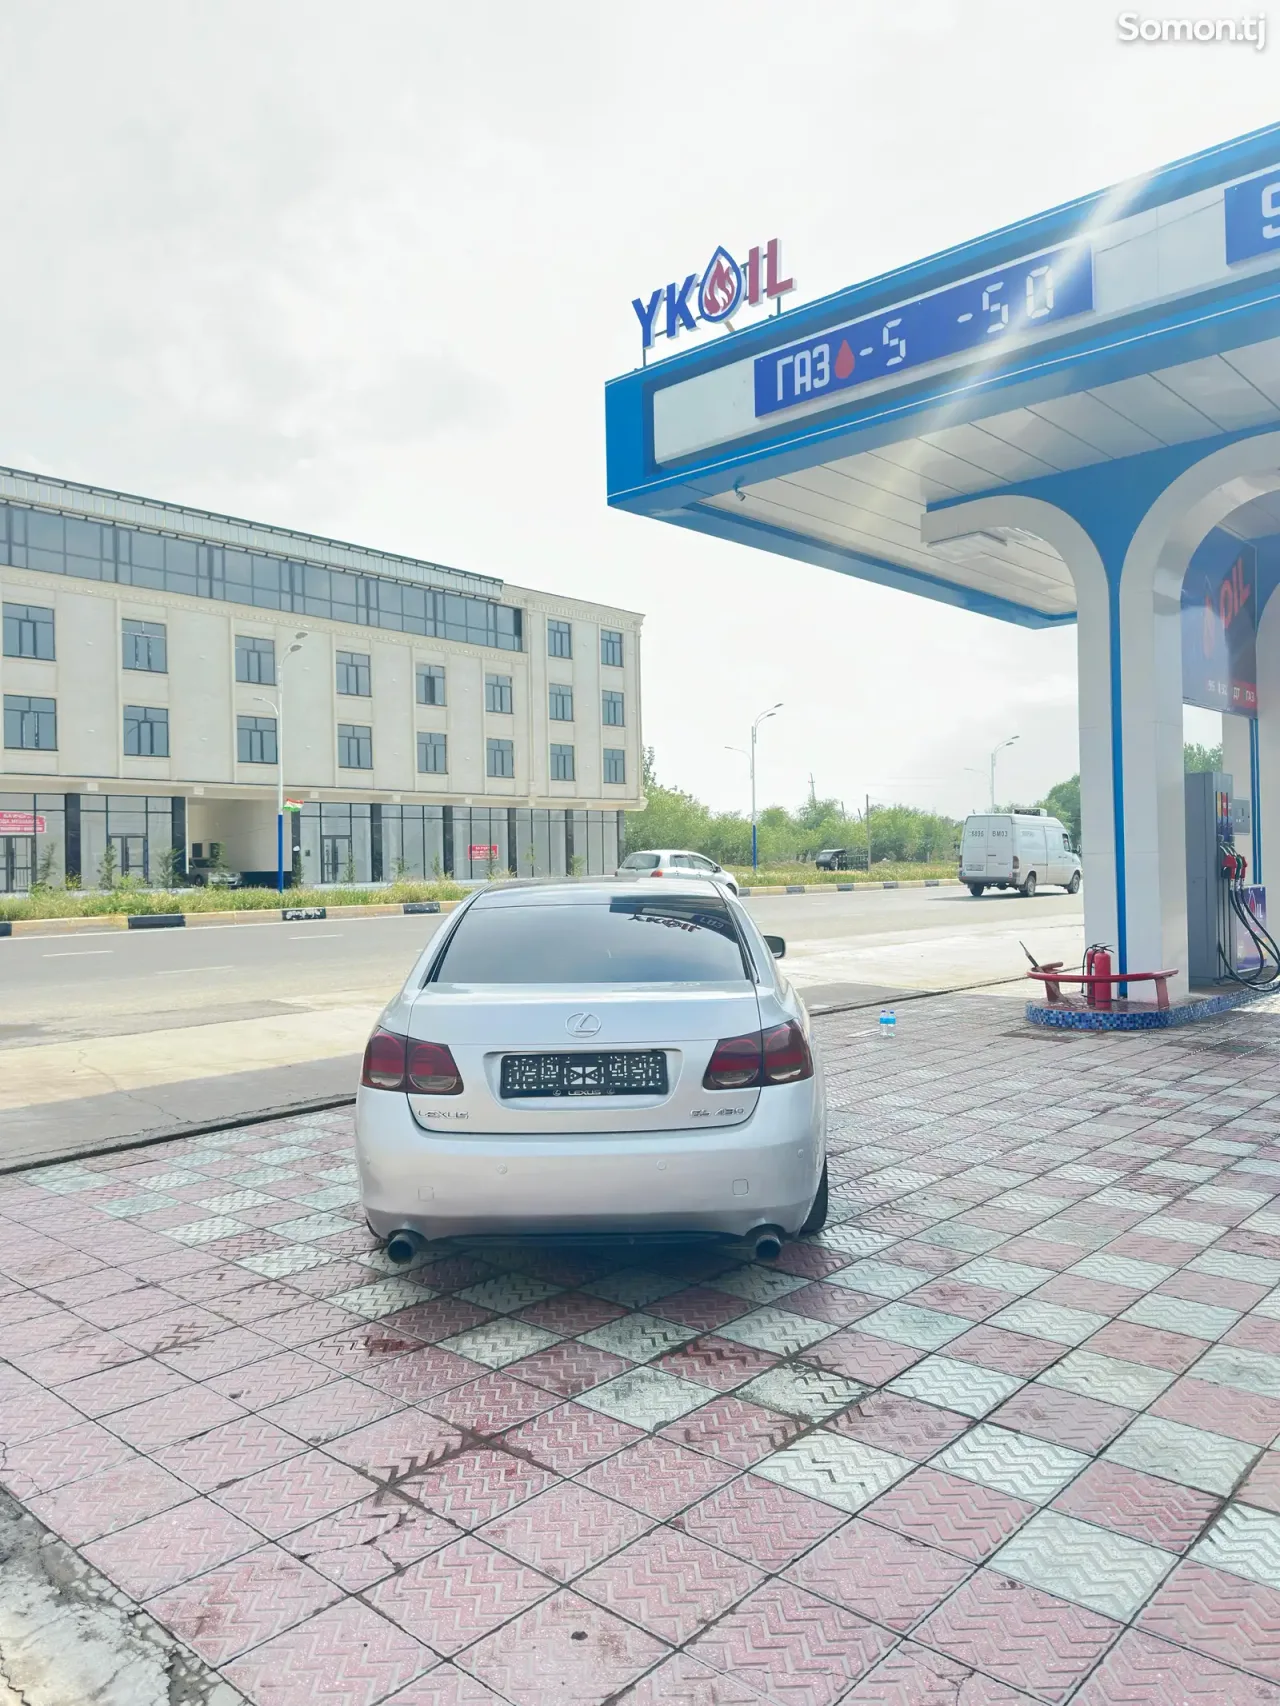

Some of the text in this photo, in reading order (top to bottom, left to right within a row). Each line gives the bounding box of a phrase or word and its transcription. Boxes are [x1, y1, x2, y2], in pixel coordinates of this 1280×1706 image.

[776, 343, 830, 401] ГАЗ
[1220, 556, 1251, 630] OIL
[418, 1110, 469, 1120] LEXUS
